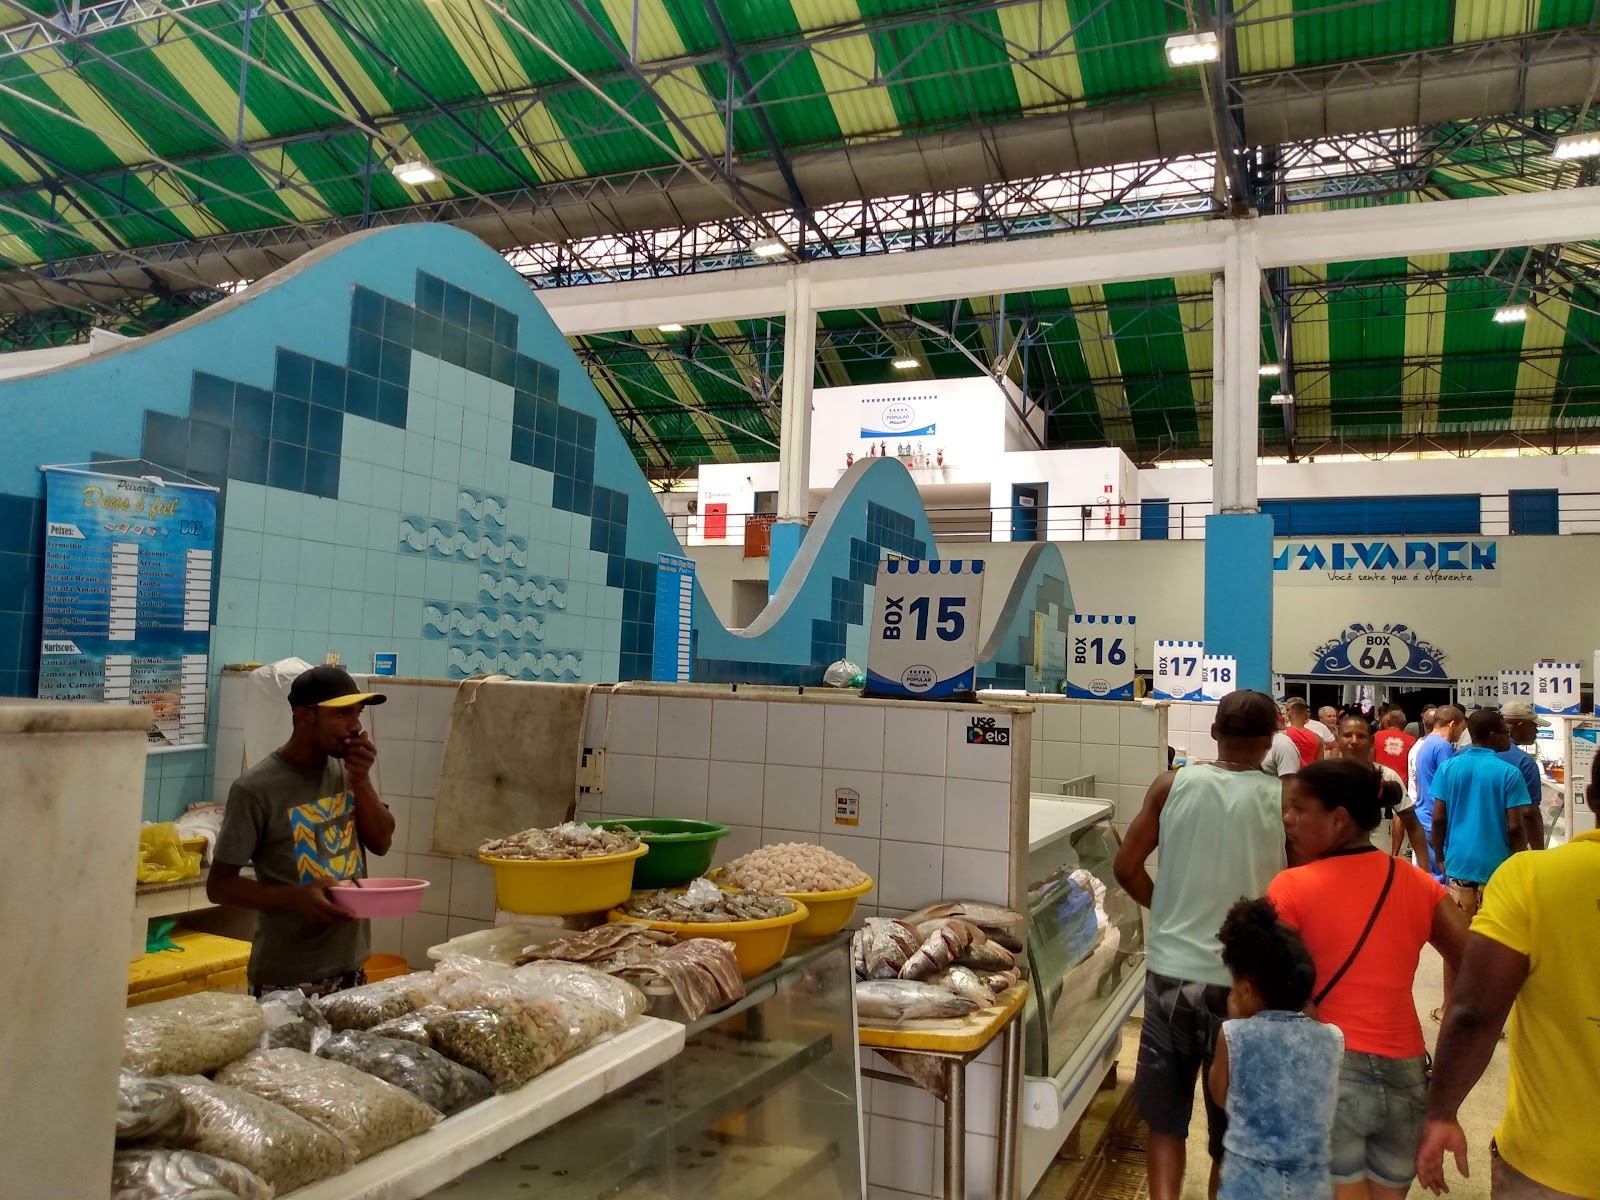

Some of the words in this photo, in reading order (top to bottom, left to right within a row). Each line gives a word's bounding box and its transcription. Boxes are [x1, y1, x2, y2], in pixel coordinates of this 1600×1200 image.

[117, 480, 156, 494] Peixaria
[83, 486, 130, 511] Deus
[136, 494, 146, 512] é
[149, 496, 178, 520] fiel
[50, 525, 74, 536] Peixes:
[180, 520, 202, 536] BOX
[48, 541, 82, 550] Vermelho
[46, 563, 71, 571] Robalo
[1328, 570, 1352, 581] Você
[1358, 572, 1386, 581] sente
[1392, 574, 1408, 584] que
[1412, 572, 1420, 581] é
[1424, 569, 1473, 584] diferente
[882, 596, 904, 640] BOX
[909, 596, 966, 642] 15
[44, 643, 75, 652] Mariscos:
[1366, 636, 1390, 646] BOX
[1075, 637, 1087, 664] BOX
[1090, 638, 1126, 665] 16
[1159, 656, 1168, 675] BOX
[1170, 657, 1197, 676] 17
[1359, 648, 1397, 670] 6A
[1210, 668, 1231, 682] 18
[1510, 682, 1530, 695] 12
[1539, 677, 1547, 694] BOX
[1550, 677, 1572, 694] 11
[972, 716, 996, 728] use
